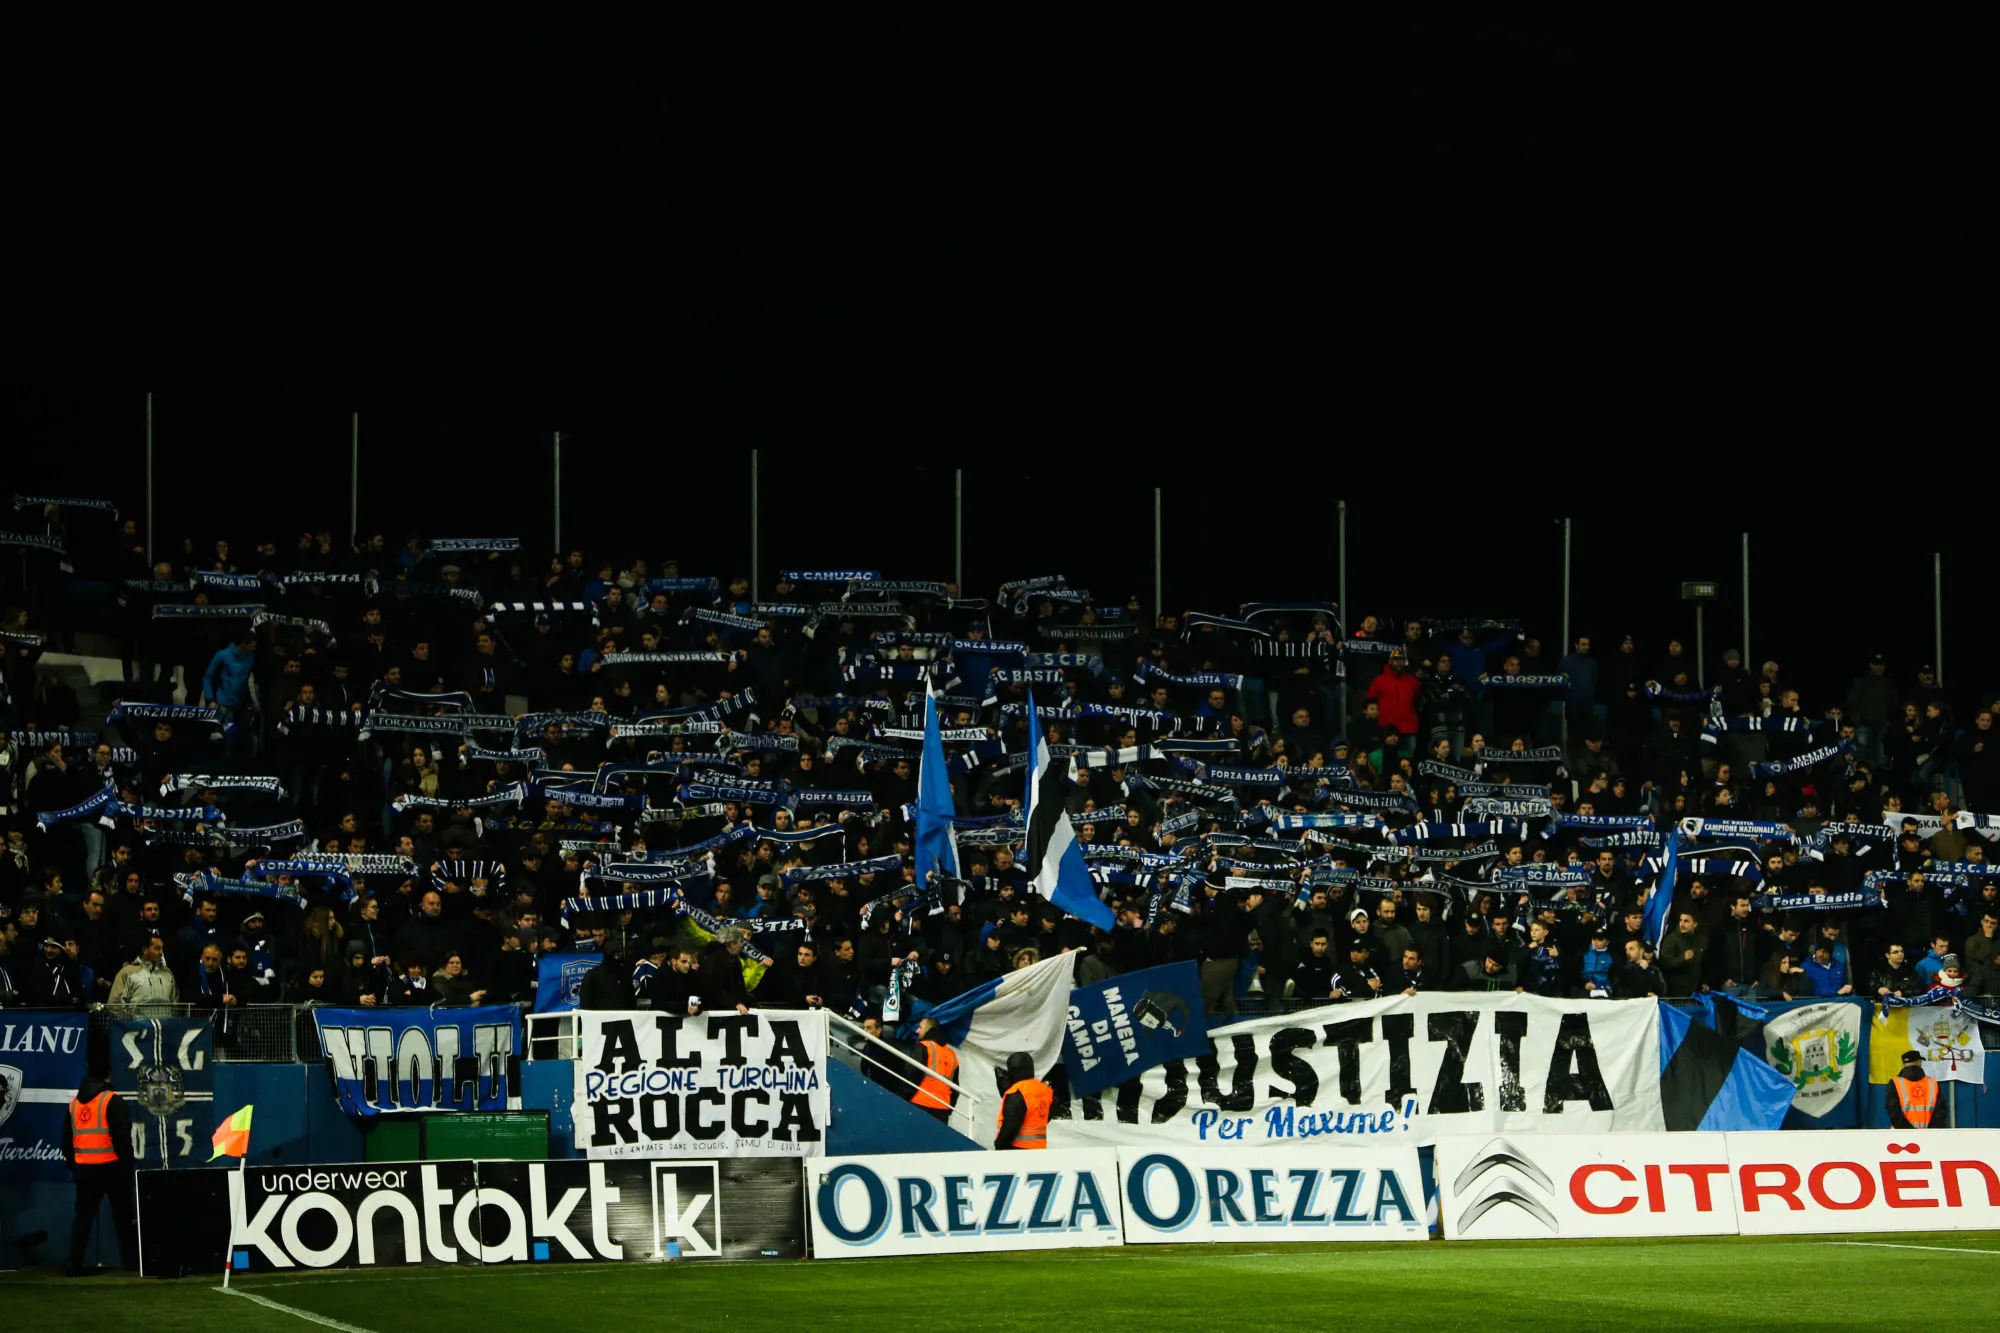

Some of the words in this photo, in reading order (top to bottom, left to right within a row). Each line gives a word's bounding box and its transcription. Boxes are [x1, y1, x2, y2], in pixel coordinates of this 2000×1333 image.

[204, 575, 235, 587] FORZA
[803, 572, 873, 581] CAHUZAC
[900, 581, 941, 592] BASTIA
[850, 604, 897, 613] BASTIA
[1186, 675, 1221, 684] BASTIA
[1507, 675, 1564, 684] BASTIA
[127, 708, 167, 718] FORZA
[171, 708, 217, 719] BASTIA
[1089, 703, 1101, 713] 18
[1105, 705, 1163, 718] CAHUZAC
[379, 716, 416, 729] FORZA
[419, 719, 460, 731] BASTIA
[468, 717, 512, 728] BASTIA
[11, 730, 26, 747] SC
[30, 731, 70, 748] BASTIA
[1484, 749, 1518, 759] FORZA
[1521, 749, 1557, 759] BASTIA
[1211, 770, 1242, 780] FORZA
[1245, 773, 1280, 782] BASTIA
[1441, 766, 1480, 783] BASTIA
[800, 793, 834, 801] FORZA
[837, 793, 873, 802] BASTIA
[1461, 785, 1498, 794] FORZA
[1503, 786, 1543, 797] BASTIA
[119, 801, 136, 815] SC
[142, 806, 204, 819] BASTIA
[1502, 801, 1548, 816] BASTIA
[1565, 815, 1603, 826] FORZA
[1608, 816, 1650, 827] BASTIA
[1830, 821, 1845, 834] SC
[1847, 824, 1895, 840] BASTIA
[1623, 830, 1661, 848] BASTIA
[259, 862, 302, 872] FORZA
[313, 855, 348, 865] FORZA
[362, 856, 401, 866] BASTIA
[1232, 860, 1270, 871] FORZA
[1527, 870, 1543, 881] SC
[1545, 871, 1583, 882] BASTIA
[1402, 881, 1449, 892] BASTIA
[1772, 894, 1811, 907] Forza
[1814, 891, 1864, 905] Bastia
[1091, 1019, 1112, 1043] DI
[1102, 986, 1140, 1067] MANERA
[594, 1014, 815, 1075] ALTA
[586, 1065, 698, 1099] REGIONE
[716, 1065, 819, 1092] TURCHINA
[587, 1087, 821, 1148] ROCCA
[1192, 1109, 1253, 1140] Per
[262, 1167, 408, 1193] underwear
[1568, 1142, 2000, 1216] CITROËN
[229, 1163, 623, 1268] kontakt
